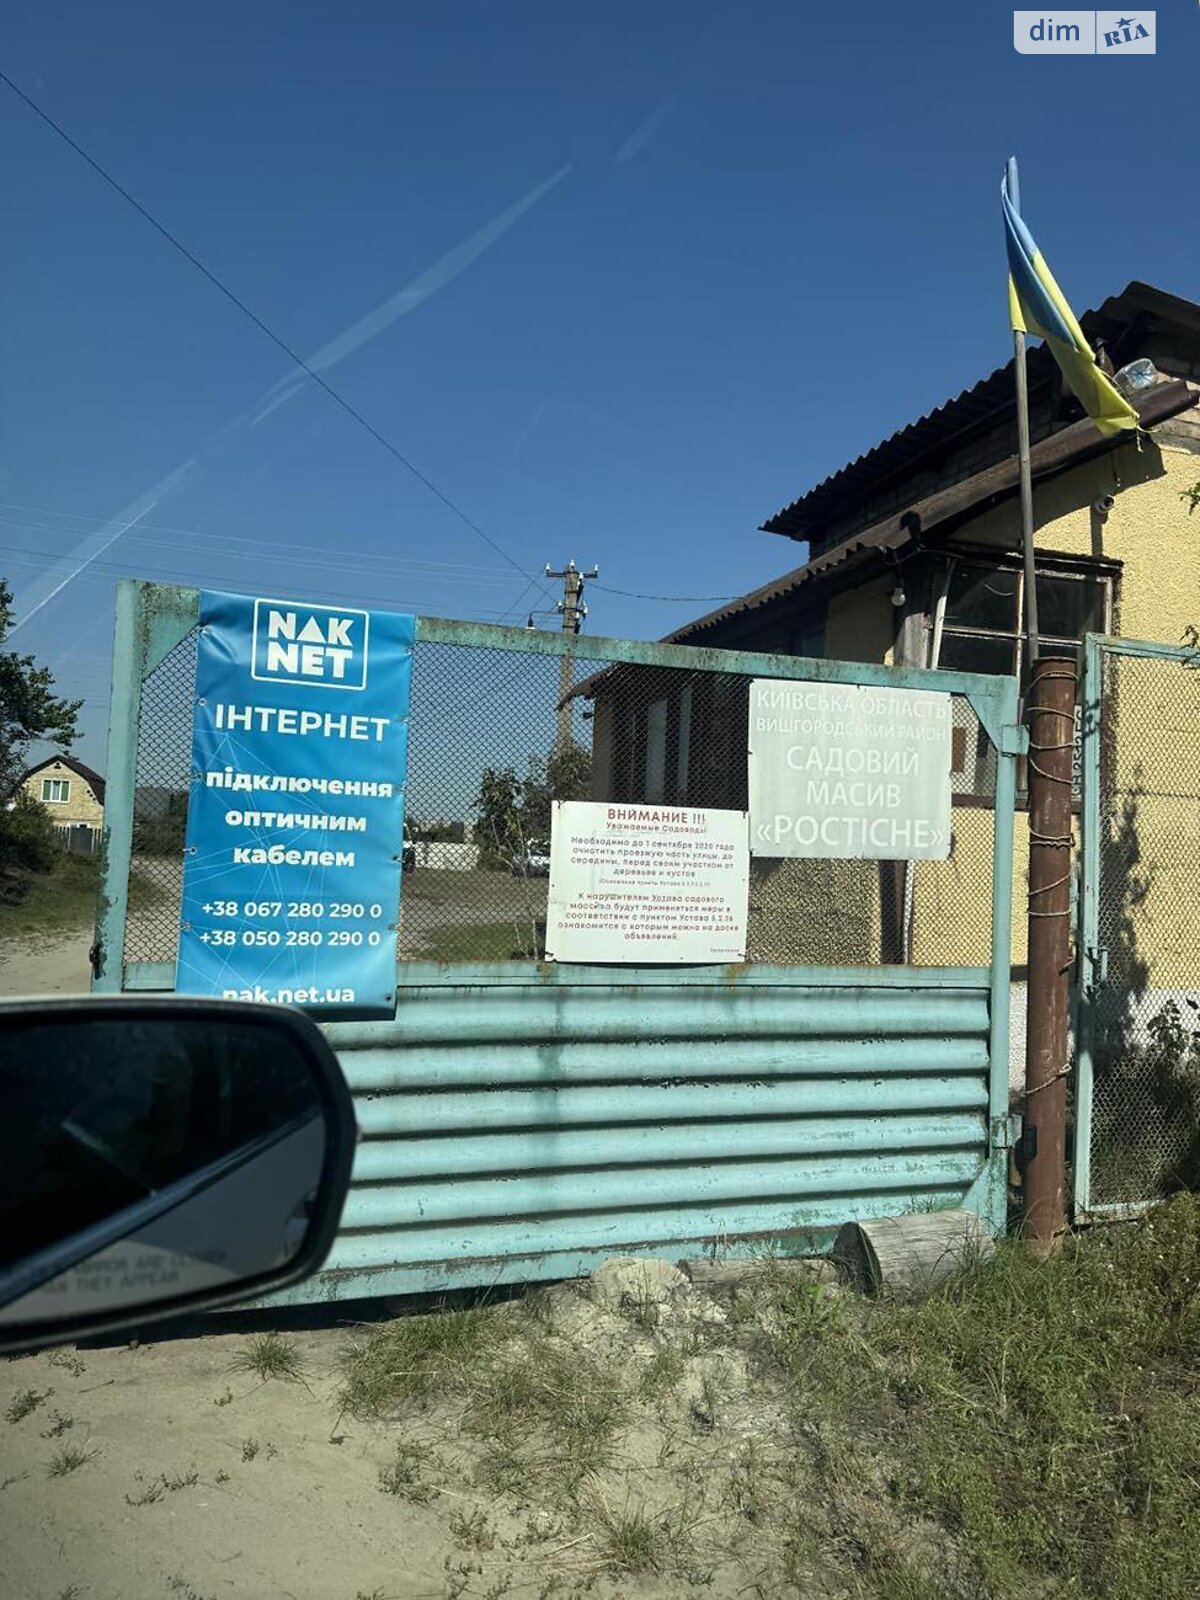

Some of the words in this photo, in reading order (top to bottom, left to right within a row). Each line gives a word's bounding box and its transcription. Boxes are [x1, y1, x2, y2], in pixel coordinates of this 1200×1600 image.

[266, 641, 354, 680] NET
[756, 688, 854, 713] КИЇВСЬКА
[860, 697, 948, 720] ОБЛАСТЬ
[215, 703, 391, 742] ІНТЕРНЕТ
[756, 717, 895, 740] ВИШГОРОДСЬКИЙ
[898, 725, 947, 742] РАЙОН
[787, 746, 920, 777] САДОВИЙ
[206, 766, 394, 798] підключення
[806, 780, 901, 808] МАСИВ
[225, 808, 367, 832] оптичним
[607, 808, 688, 823] ВНИМАНИЕ
[692, 813, 706, 825] !!!
[606, 822, 659, 831] Уважаемые
[756, 814, 945, 848] «РОСТІСНЕ»
[571, 836, 630, 846] Необходимо
[652, 841, 693, 849] сентября
[232, 844, 356, 867] кабелем
[572, 847, 616, 855] очистить
[617, 849, 664, 858] проезжую
[613, 868, 656, 876] деревьев
[623, 859, 651, 867] перед
[682, 861, 723, 869] участком
[587, 893, 649, 902] нарушителям
[651, 894, 683, 902] Устава
[202, 901, 239, 918] +38
[243, 902, 283, 918] 067
[287, 903, 324, 919] 280
[328, 903, 366, 919] 290
[370, 904, 382, 919] 0
[565, 912, 630, 920] соответствии
[613, 903, 639, 911] будут
[558, 922, 619, 930] ознакомится
[200, 930, 237, 946] +38
[242, 930, 281, 947] 050
[286, 930, 324, 947] 280
[327, 930, 365, 947] 290
[368, 931, 381, 947] 0
[222, 985, 356, 1004] nak.net.ua
